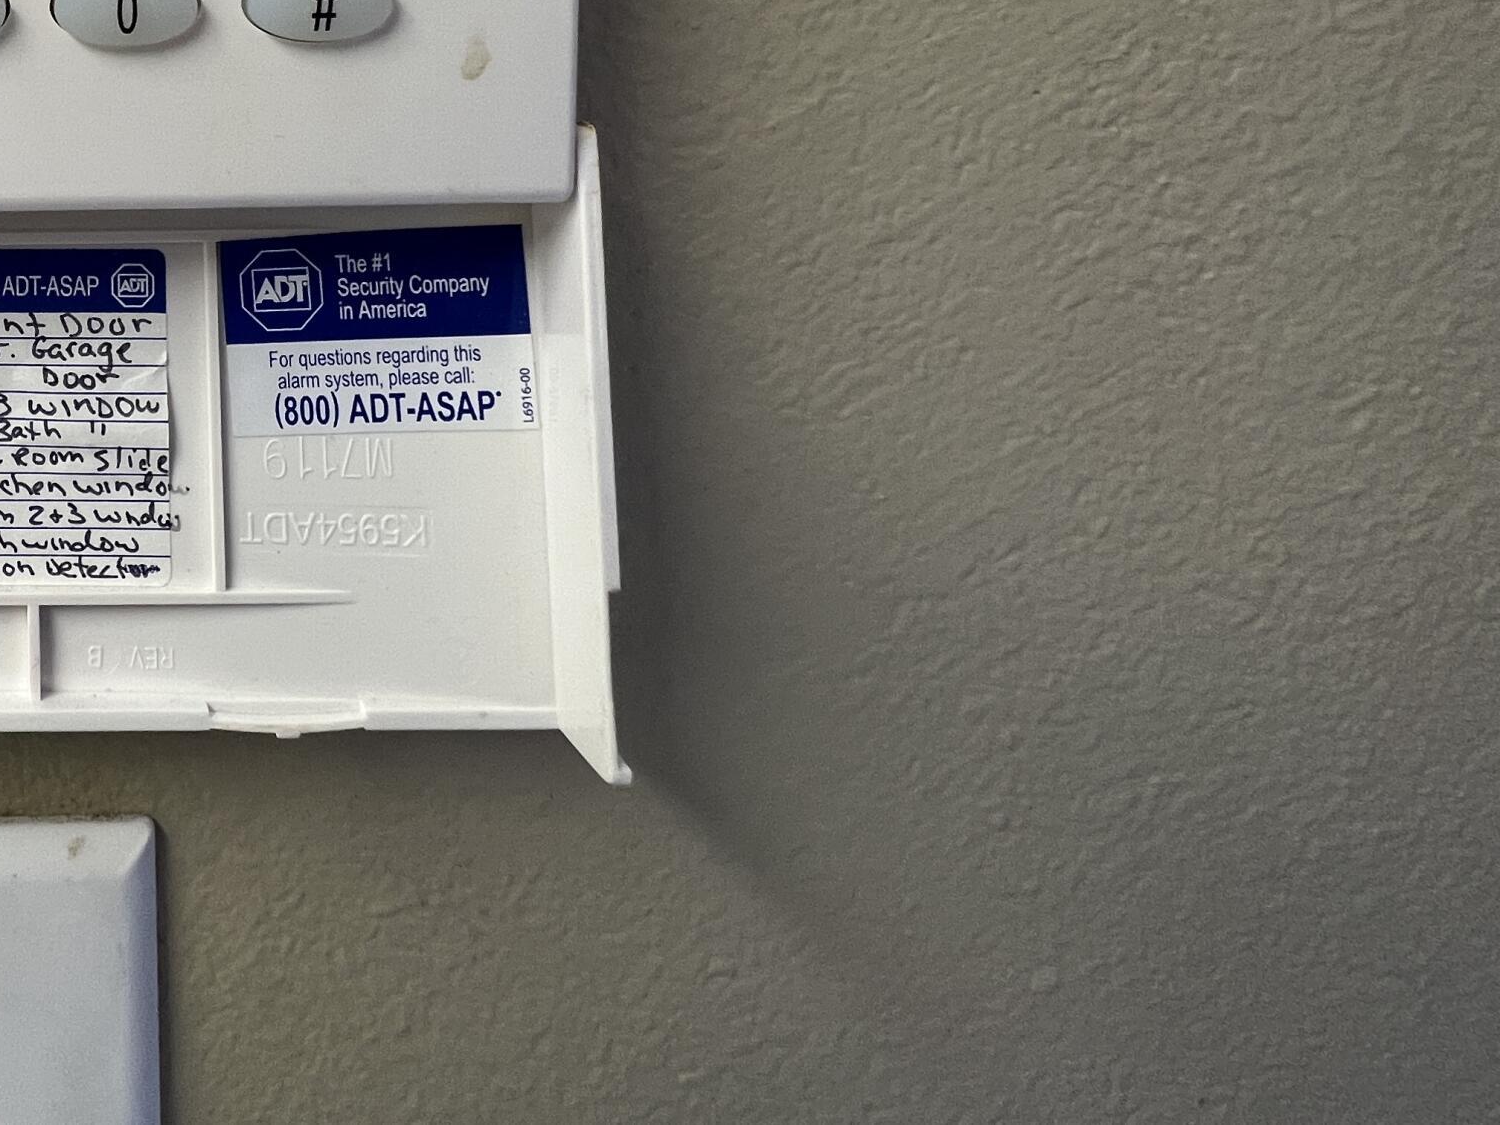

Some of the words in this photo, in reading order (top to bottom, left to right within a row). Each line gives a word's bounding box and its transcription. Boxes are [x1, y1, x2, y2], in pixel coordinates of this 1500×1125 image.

[335, 255, 366, 273] The
[372, 253, 392, 272] #1
[2, 275, 99, 297] ADT-ASAP
[119, 276, 147, 293] ADT
[256, 275, 308, 303] ADT
[338, 277, 403, 299] Security
[409, 275, 489, 297] Company
[339, 302, 353, 320] in
[359, 301, 427, 319] America
[31, 336, 132, 373] Garage
[269, 350, 294, 367] For
[298, 348, 371, 369] questions
[376, 346, 450, 367] regarding
[454, 345, 482, 362] this
[278, 372, 320, 388] alarm
[325, 370, 384, 390] system,
[389, 369, 440, 389] please
[444, 367, 475, 384] call:
[520, 367, 534, 423] L6916-00
[275, 392, 339, 428] (800)
[12, 448, 84, 468] Room
[29, 505, 44, 525] 2
[67, 504, 86, 525] 3
